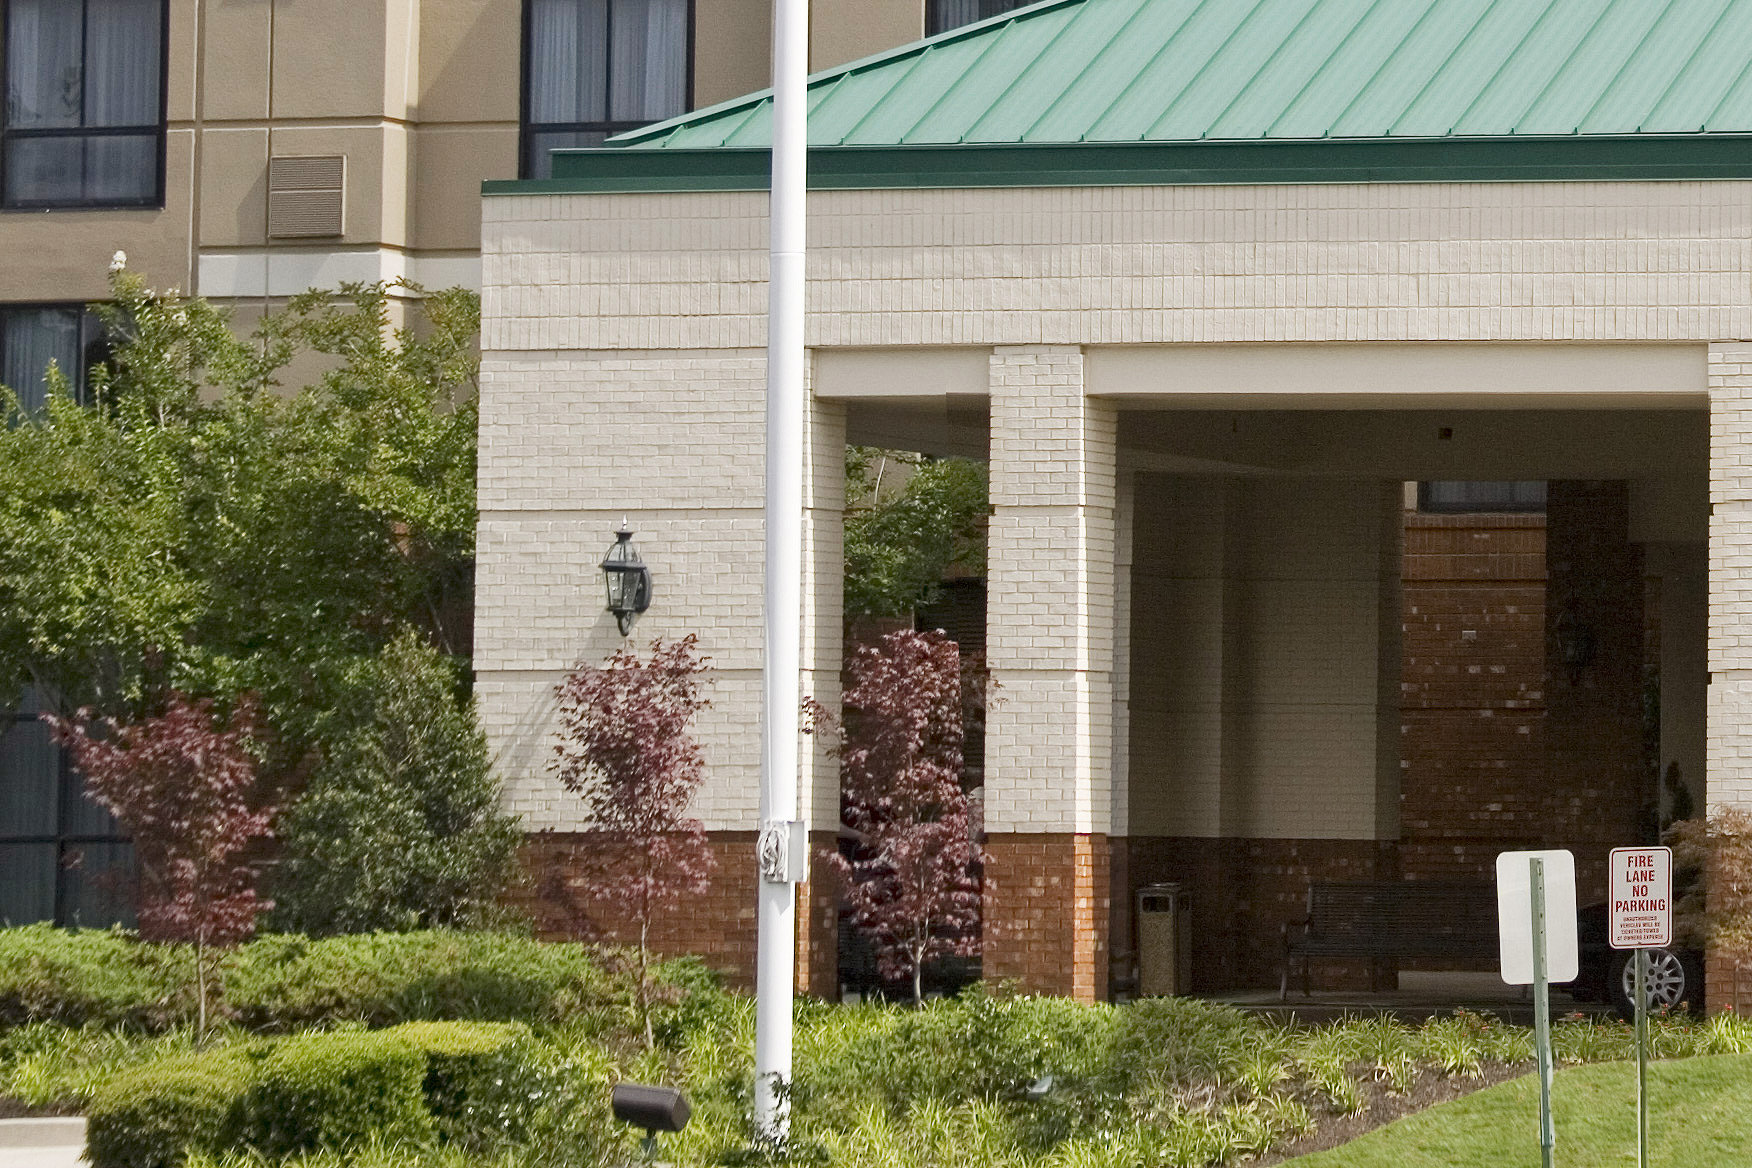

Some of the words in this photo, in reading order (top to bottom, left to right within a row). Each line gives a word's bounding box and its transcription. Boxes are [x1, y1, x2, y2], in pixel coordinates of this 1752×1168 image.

[1627, 855, 1654, 868] FIRE
[1626, 870, 1656, 883] LANE
[1632, 884, 1648, 897] NO
[1615, 898, 1666, 912] PARKING
